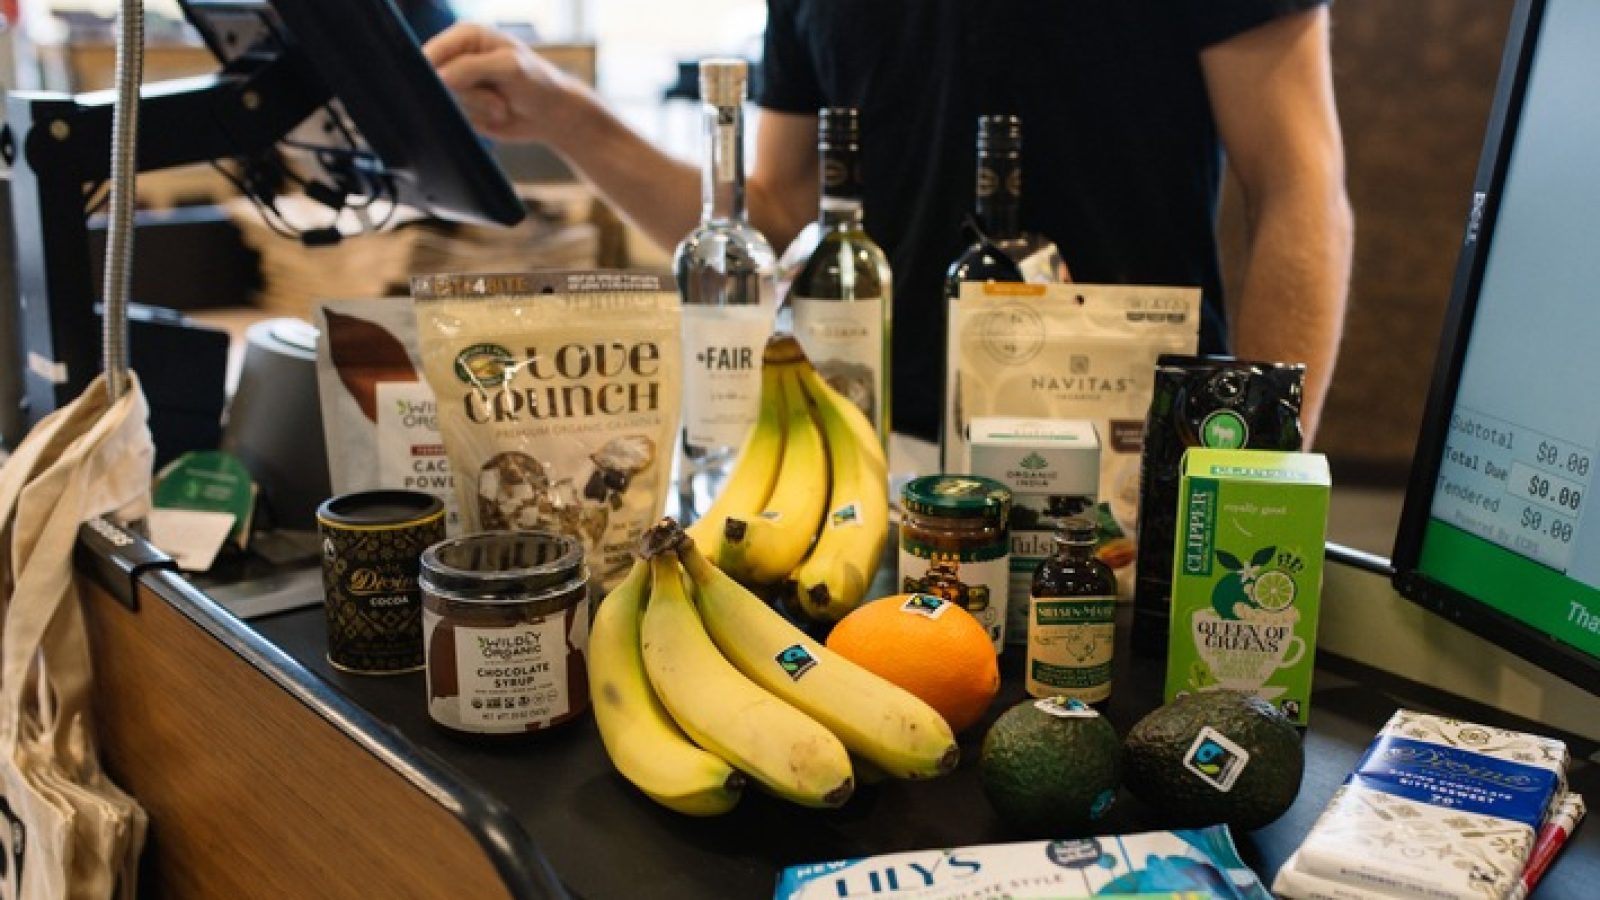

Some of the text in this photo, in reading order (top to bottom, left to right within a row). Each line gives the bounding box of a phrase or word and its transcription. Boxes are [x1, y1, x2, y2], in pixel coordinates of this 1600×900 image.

[706, 347, 753, 369] FAIR
[1031, 376, 1128, 392] NAVITAS
[1452, 414, 1590, 476] Subtotal $0.00
[413, 460, 448, 472] CAC
[1445, 445, 1581, 511] Total Due $0.00
[1439, 475, 1573, 543] Tendered $0.00
[1568, 599, 1600, 635] Tha
[1197, 622, 1290, 640] QUEEN OF
[477, 662, 549, 677] CHOCOLATE
[494, 676, 535, 688] SYRUP
